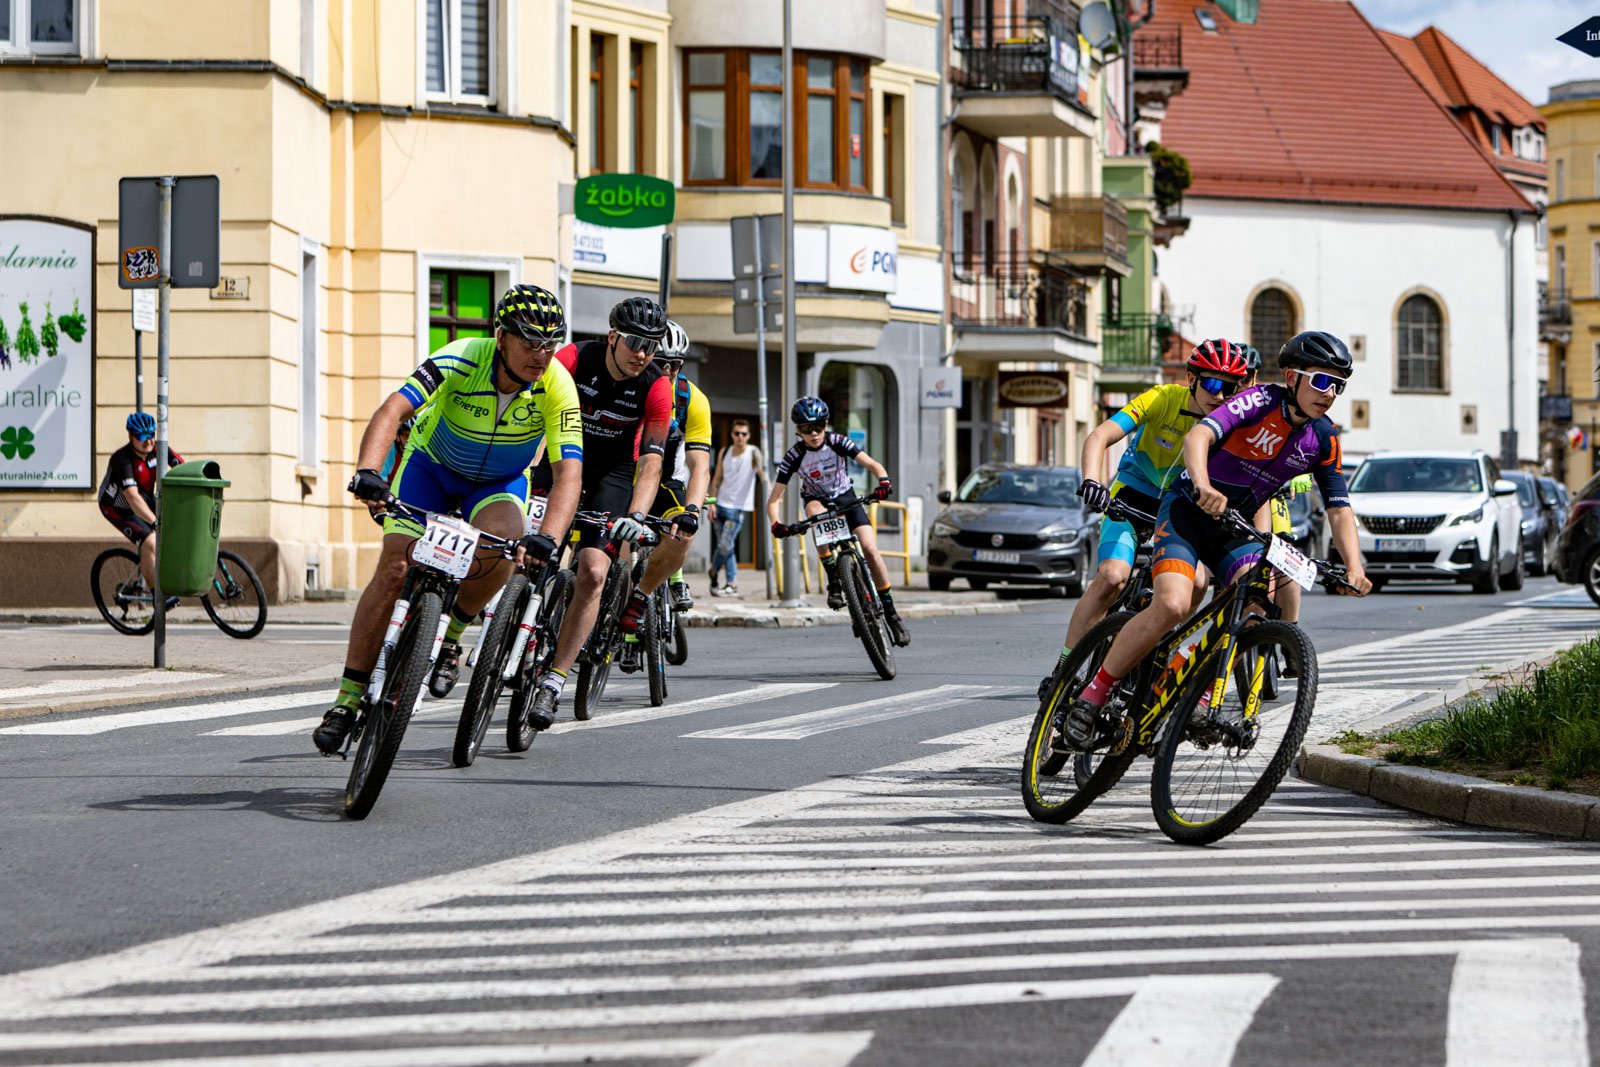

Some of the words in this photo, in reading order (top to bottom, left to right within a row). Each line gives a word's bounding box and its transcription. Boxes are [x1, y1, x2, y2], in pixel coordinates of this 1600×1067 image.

[586, 182, 666, 207] żabka
[225, 279, 236, 291] 12
[452, 396, 489, 418] Energo
[816, 518, 845, 534] 1889
[428, 526, 474, 555] 1717
